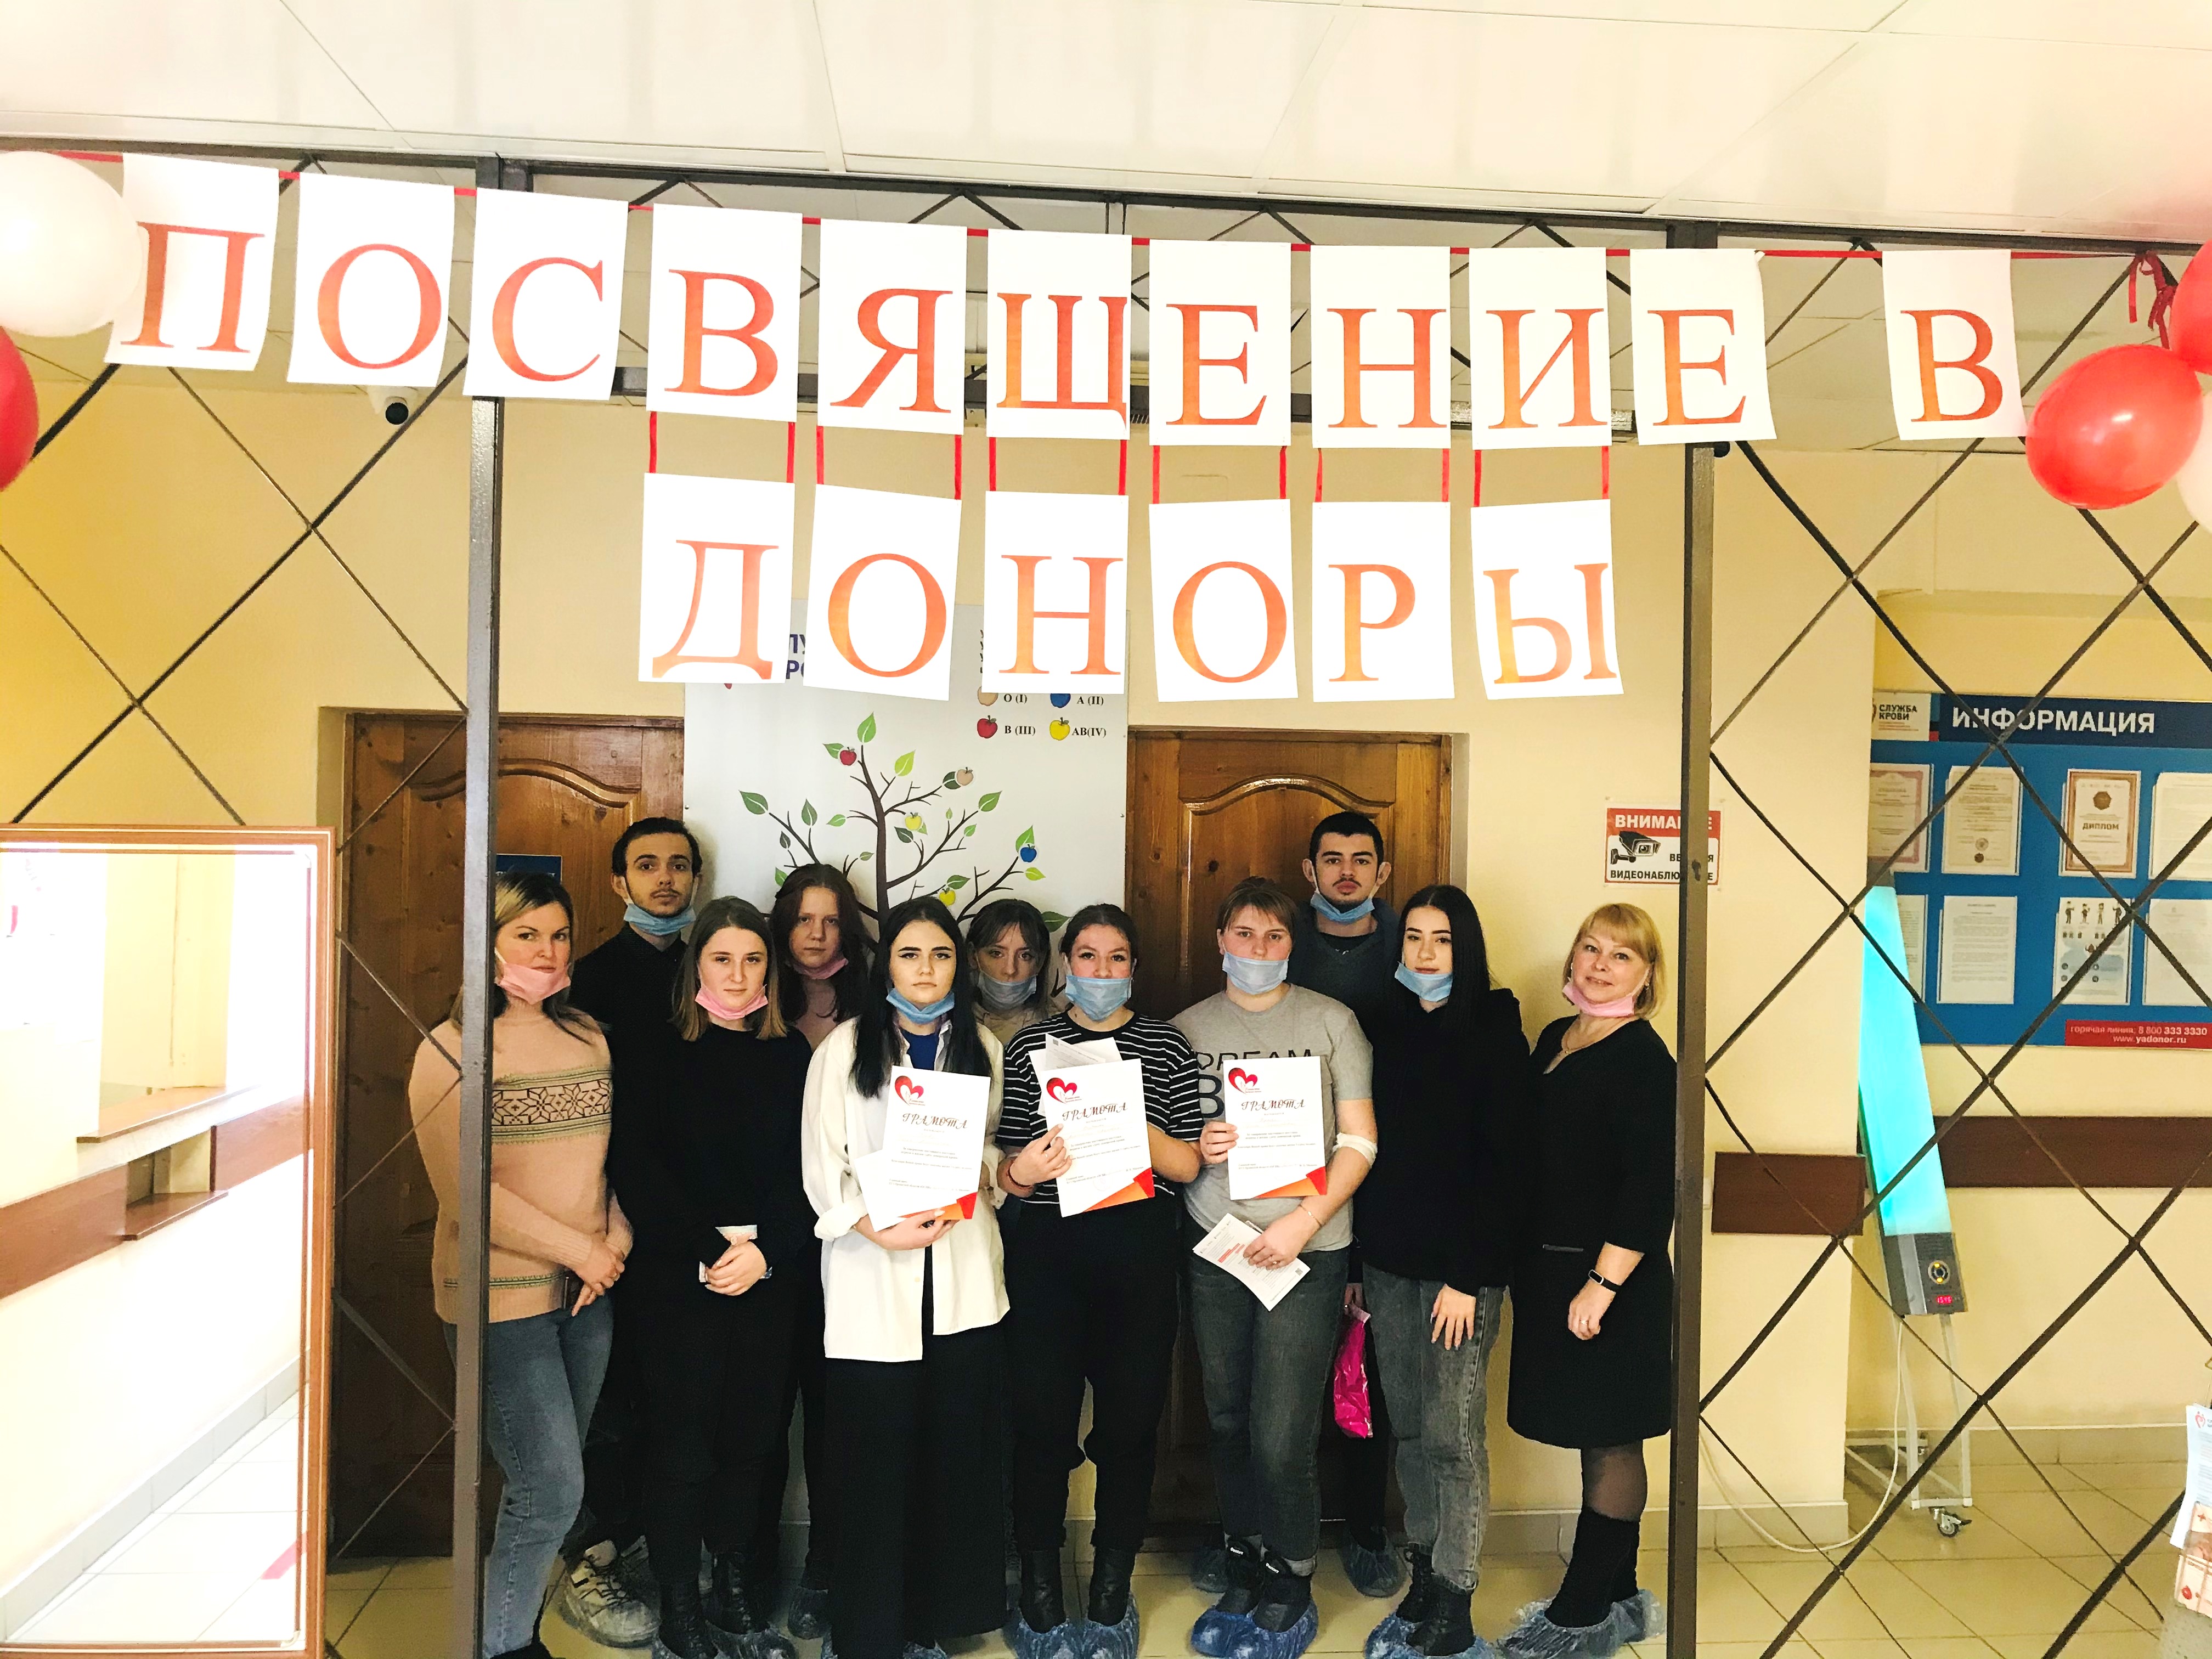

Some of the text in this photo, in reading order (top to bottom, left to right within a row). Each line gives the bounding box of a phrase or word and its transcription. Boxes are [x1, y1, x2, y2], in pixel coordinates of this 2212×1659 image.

[120, 222, 2004, 430] ПОСВЯЩЕНИЕ В
[652, 539, 1617, 685] ДОНОРЫ
[1076, 696, 1104, 706] A (II)
[1880, 704, 1917, 713] СЛУЖБА
[1952, 707, 2155, 737] ИНФОРМАЦИЯ
[1004, 725, 1012, 734] B
[1615, 814, 1712, 830] ВНИМА
[1610, 870, 1713, 881] ВИДЕОНАБЛЮЕ
[2070, 1026, 2105, 1035] горячая
[2164, 1026, 2182, 1035] 333
[2183, 1027, 2208, 1036] 3330
[1062, 1102, 1128, 1121] ГРАМОТА
[1241, 1099, 1306, 1111] ГРАМОТА
[902, 1113, 968, 1130] ГРАМОТА
